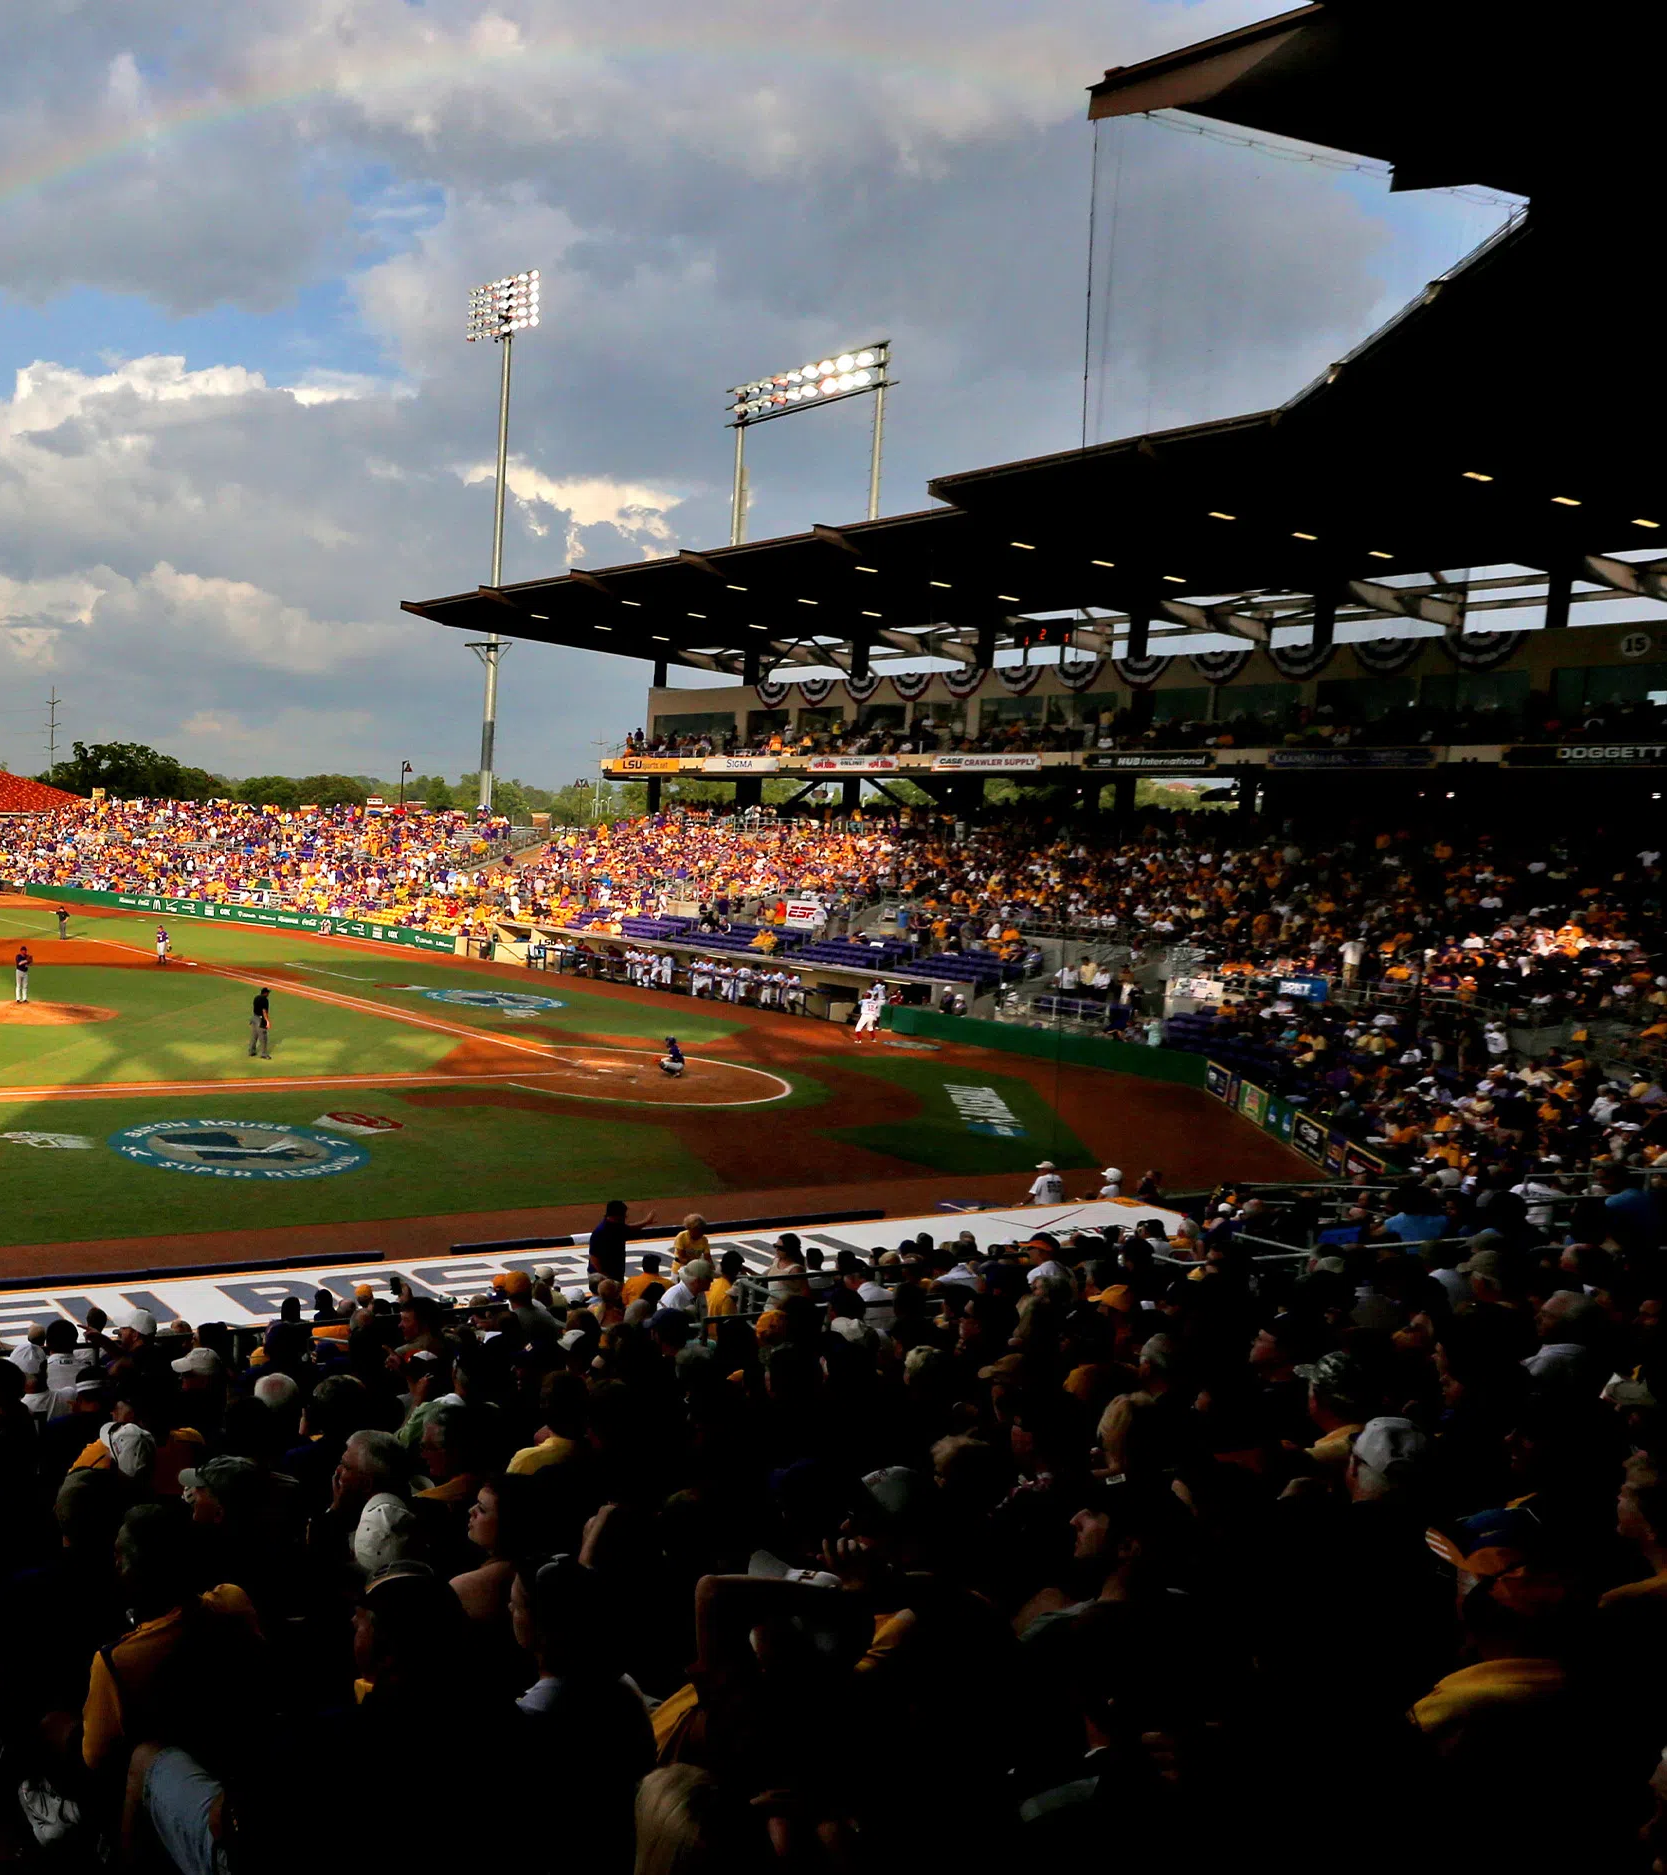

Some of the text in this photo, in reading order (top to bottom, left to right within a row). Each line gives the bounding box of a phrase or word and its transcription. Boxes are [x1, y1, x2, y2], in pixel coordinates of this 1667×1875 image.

[1558, 747, 1665, 758] DOGGETT
[622, 761, 642, 769] LSU
[726, 758, 752, 768] SIGMA
[1117, 756, 1205, 765] HUB International
[200, 1120, 292, 1132] ROUGE
[157, 1161, 252, 1178] SUPER
